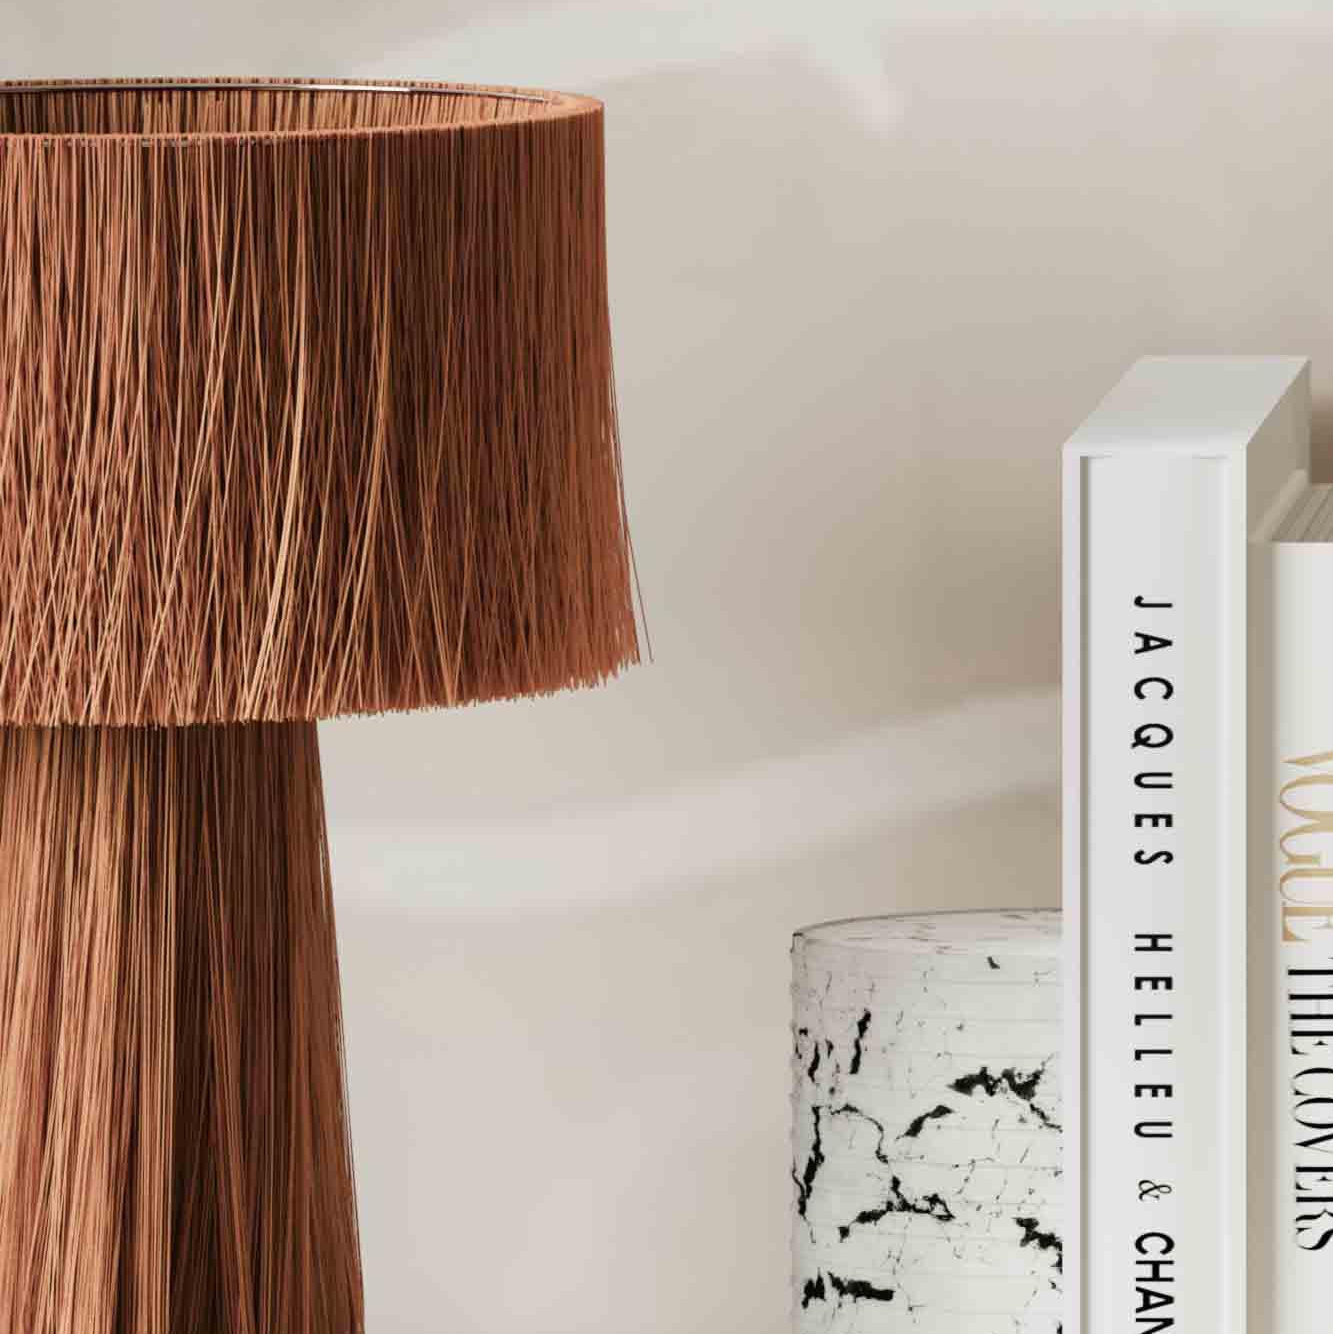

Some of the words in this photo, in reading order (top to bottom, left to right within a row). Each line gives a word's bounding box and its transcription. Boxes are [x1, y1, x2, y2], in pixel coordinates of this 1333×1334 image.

[1130, 594, 1174, 866] JACQUES
[1133, 932, 1174, 1140] HELLEU
[1137, 1178, 1173, 1201] &
